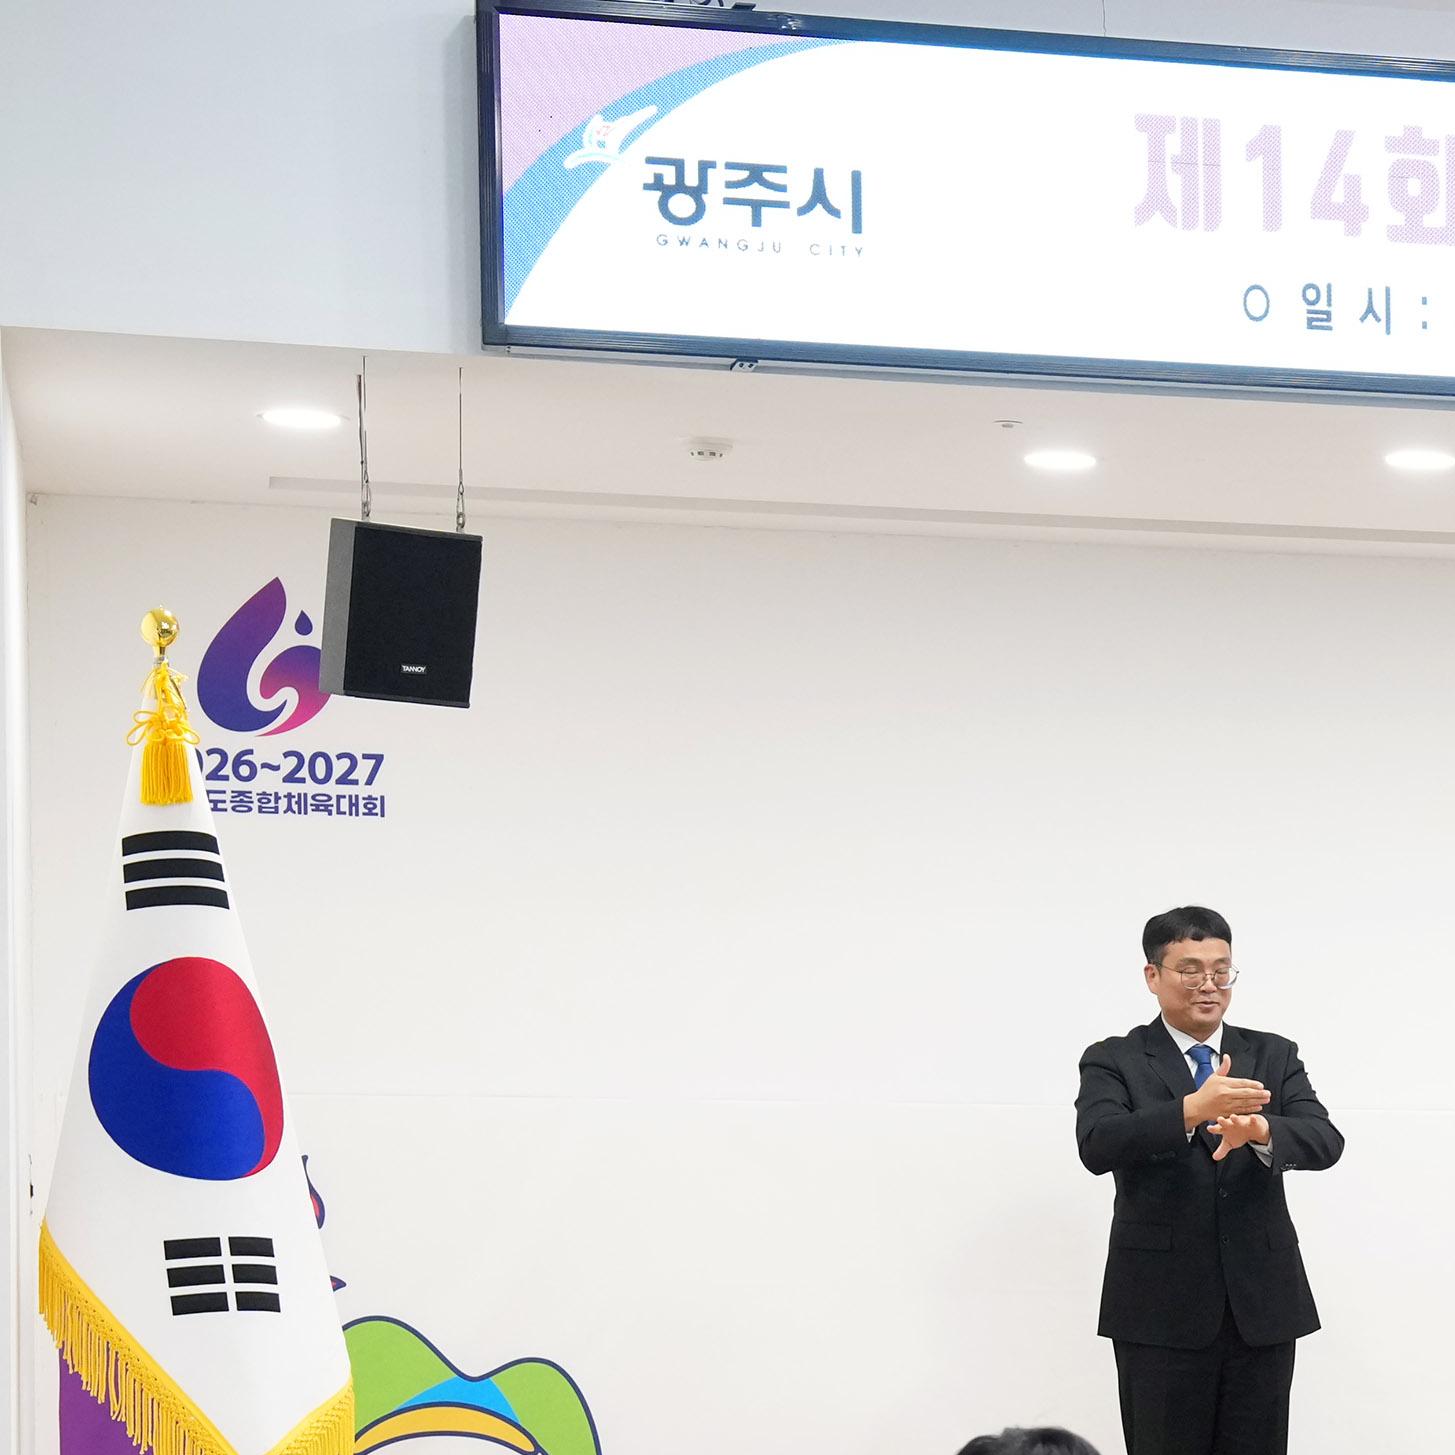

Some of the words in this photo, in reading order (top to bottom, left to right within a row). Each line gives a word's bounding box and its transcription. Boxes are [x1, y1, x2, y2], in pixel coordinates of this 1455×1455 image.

[643, 156, 862, 234] 광주시
[656, 234, 782, 254] GWANGJU
[809, 243, 863, 256] CITY
[1302, 283, 1333, 331] 일
[1359, 286, 1391, 335] 시
